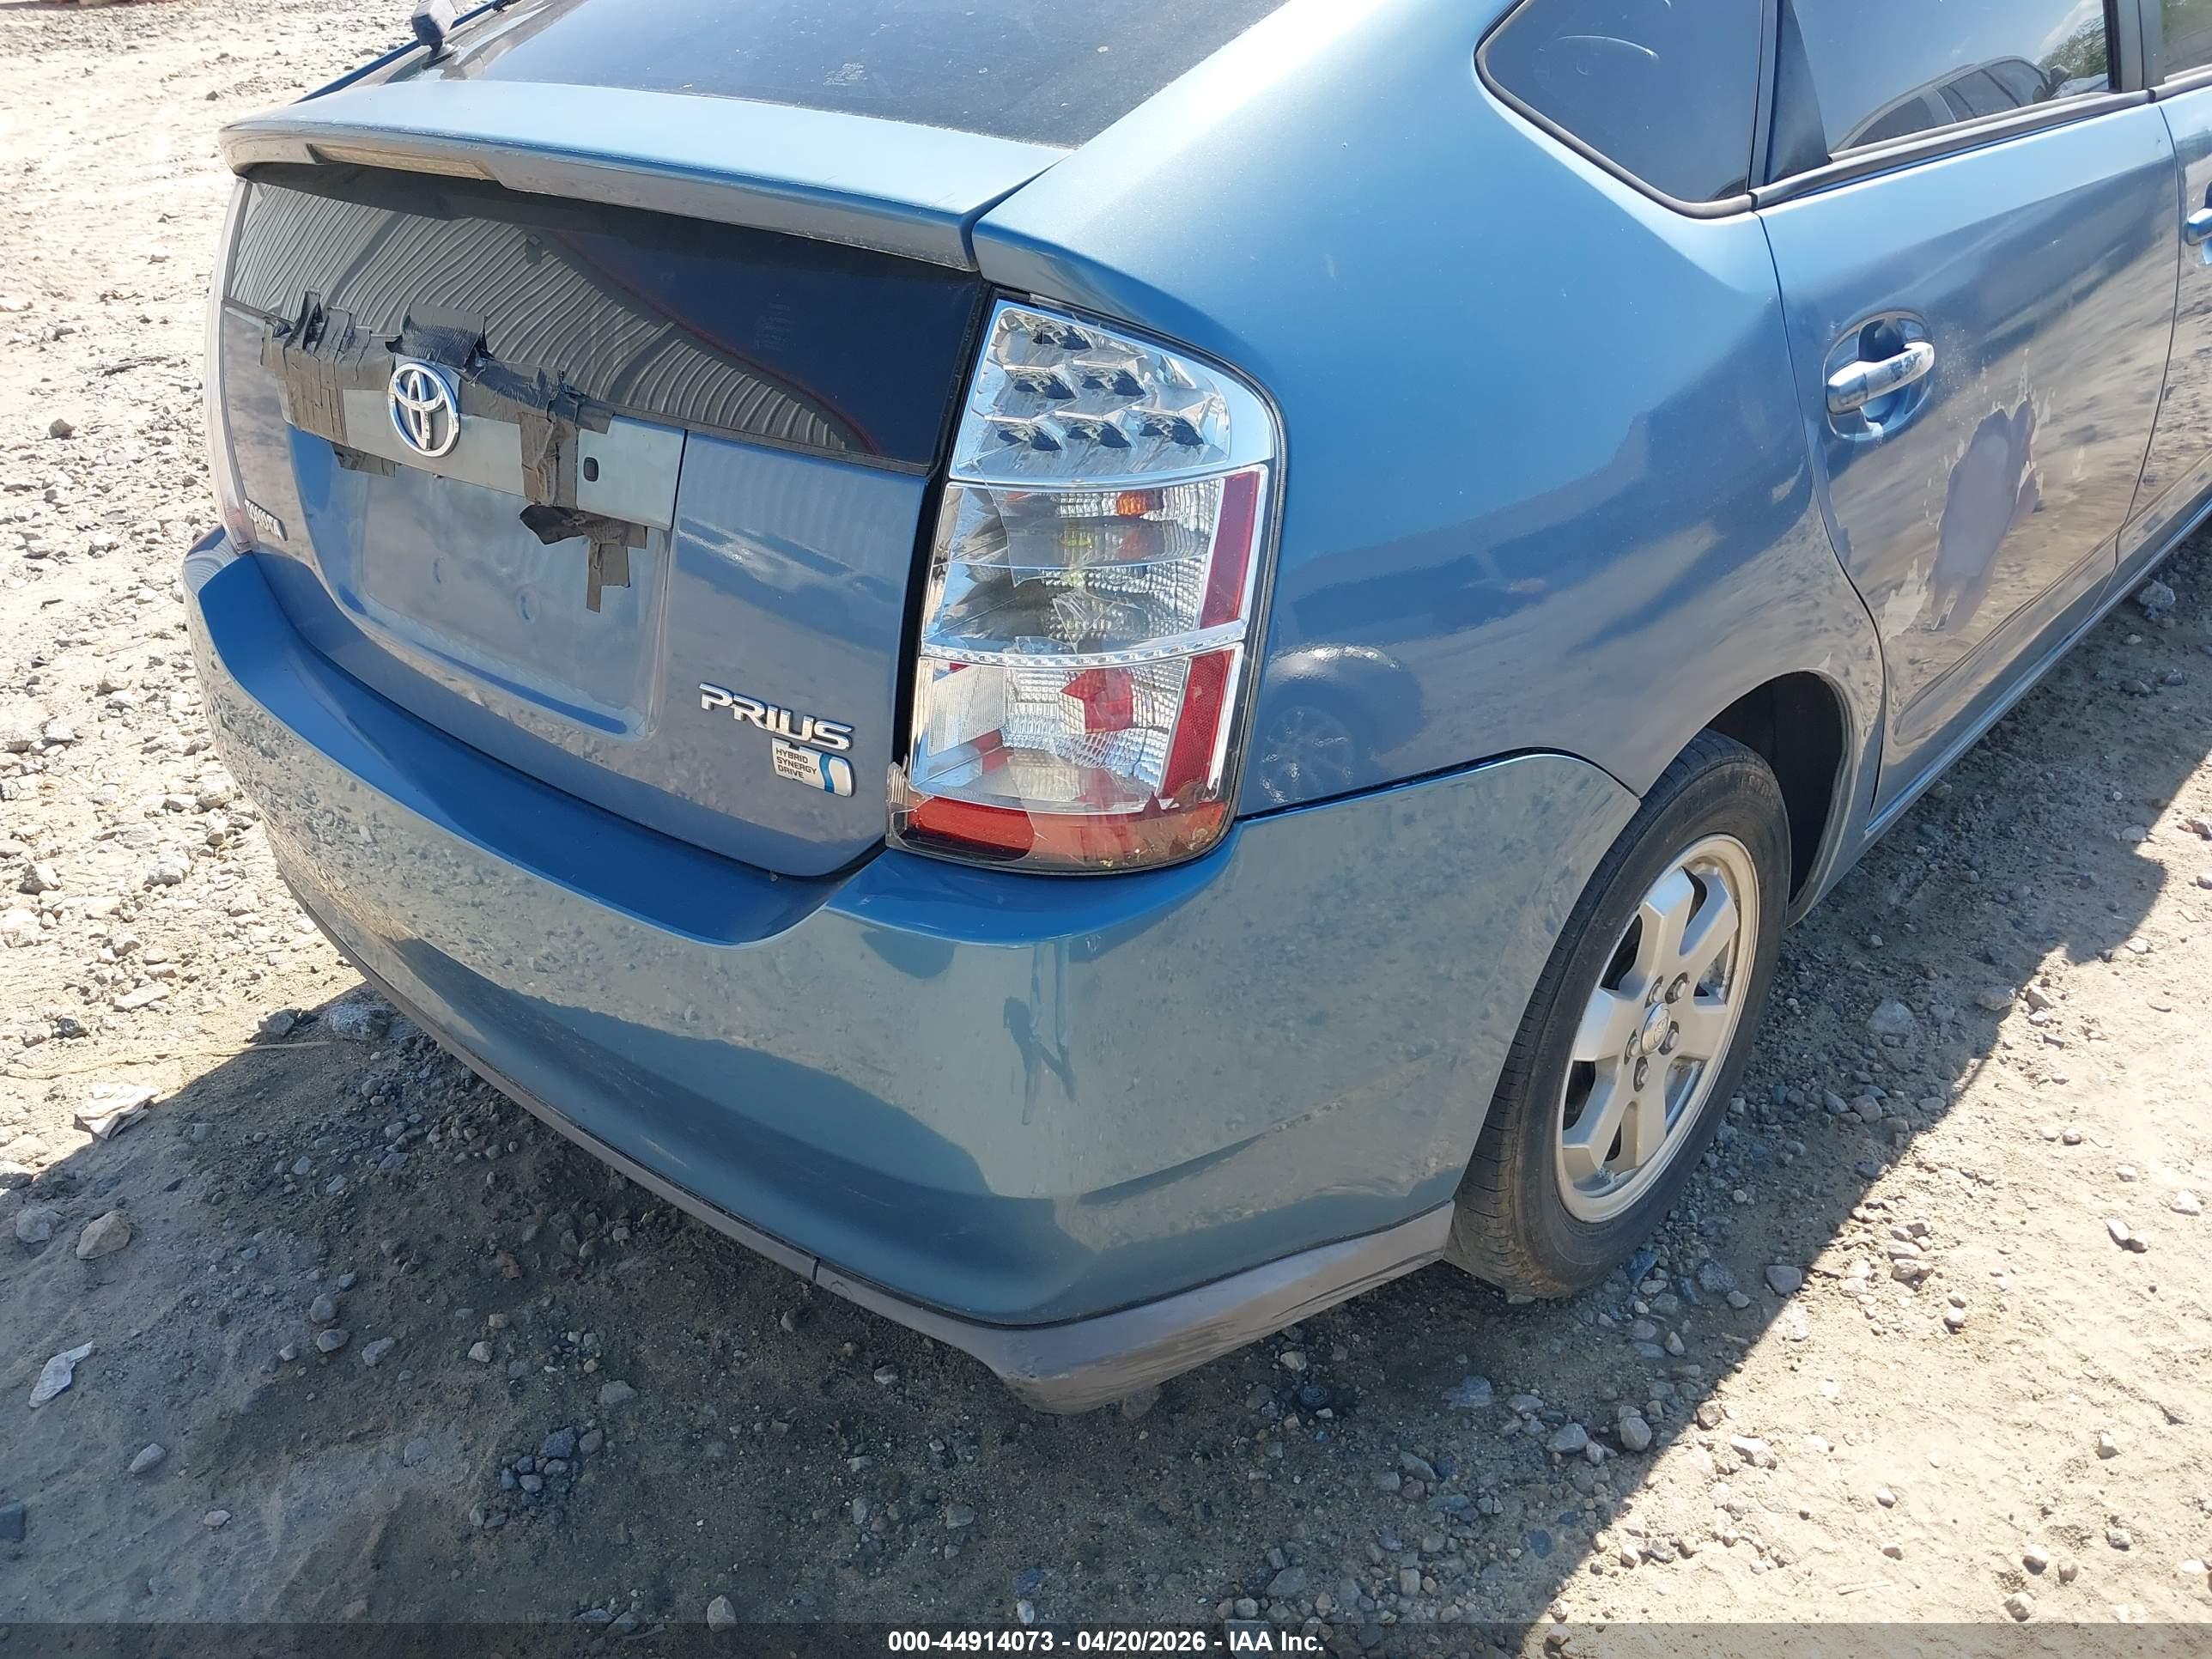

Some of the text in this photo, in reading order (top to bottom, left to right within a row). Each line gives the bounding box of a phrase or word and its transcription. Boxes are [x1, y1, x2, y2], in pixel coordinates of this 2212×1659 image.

[244, 498, 285, 541] TOYOTA
[698, 682, 854, 751] PRIUS
[775, 747, 809, 764] HYBRID
[776, 756, 817, 775] SYNERGY
[777, 764, 805, 779] DRIVE
